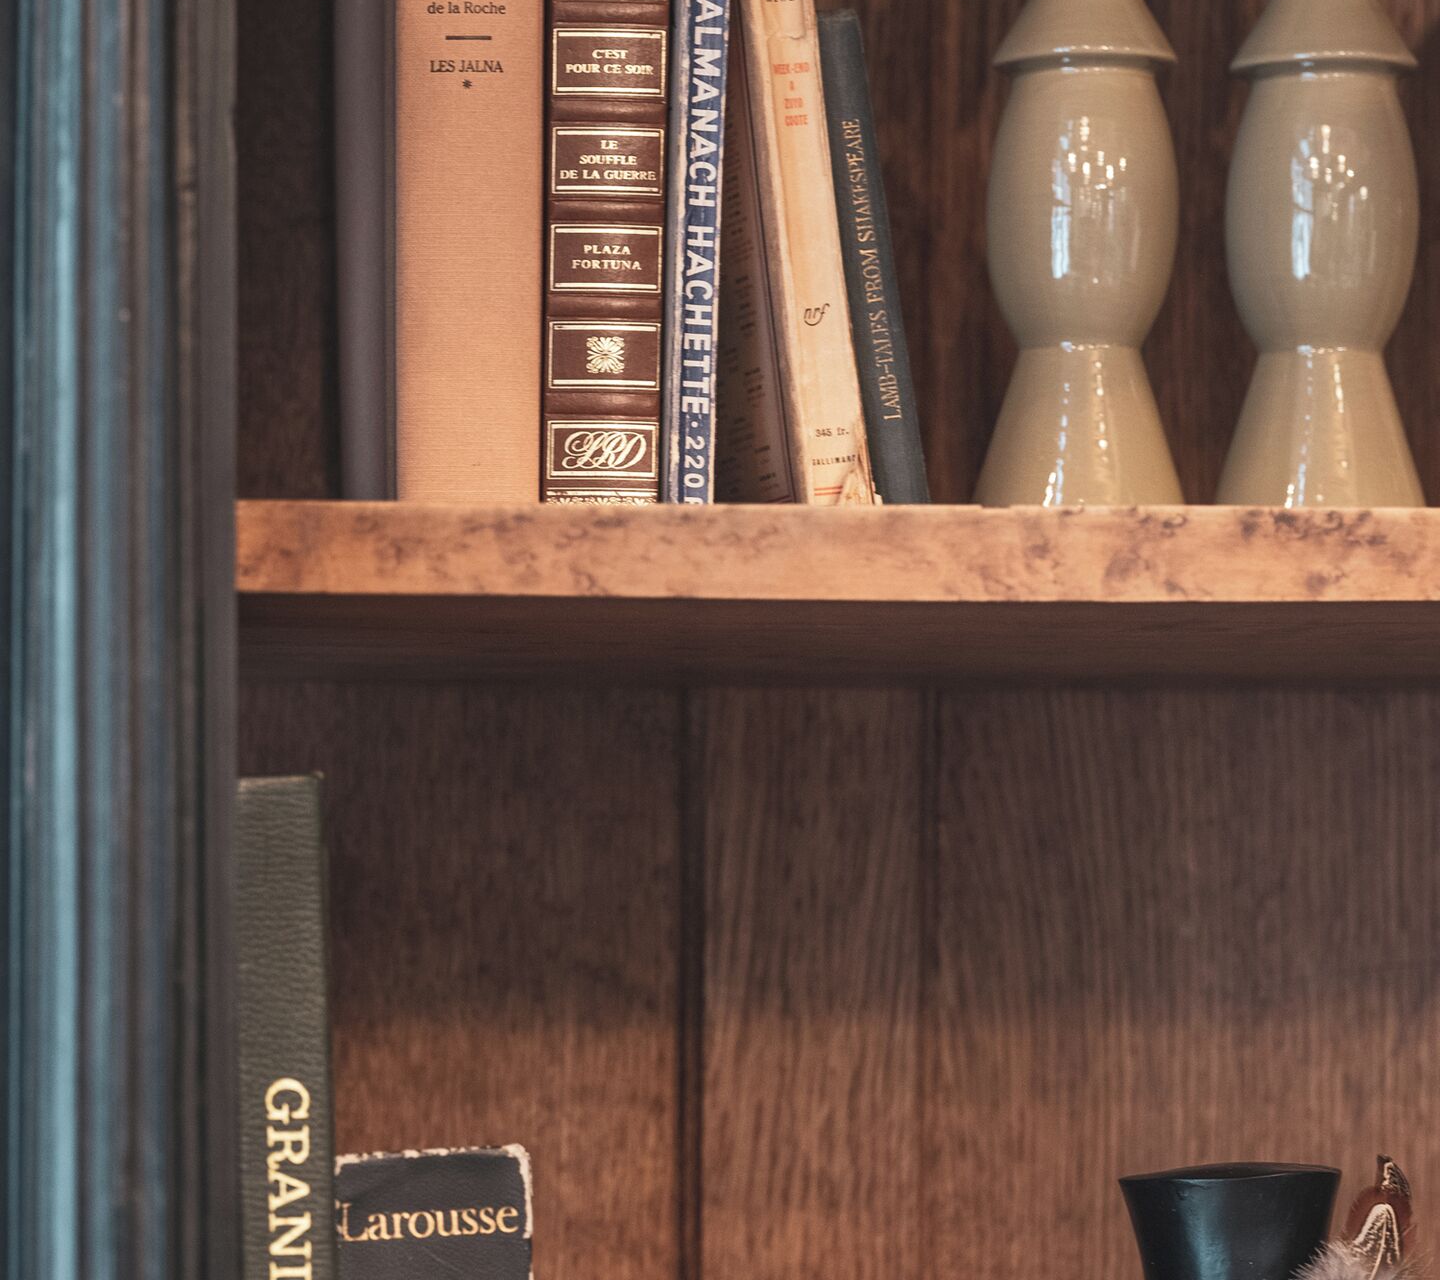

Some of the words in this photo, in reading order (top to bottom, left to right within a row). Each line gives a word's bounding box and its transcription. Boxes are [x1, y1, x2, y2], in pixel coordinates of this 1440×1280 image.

[427, 2, 445, 14] de
[448, 2, 460, 14] la
[464, 2, 506, 14] Roche
[430, 60, 455, 73] LES
[459, 60, 504, 73] JALNA
[565, 64, 600, 74] POUR
[603, 64, 622, 74] CE
[624, 65, 654, 75] SOIR
[600, 140, 619, 150] LE
[579, 155, 638, 165] SOUFFLE
[559, 170, 578, 179] DE
[583, 170, 600, 179] LA
[604, 170, 656, 181] GUERRE
[842, 119, 876, 243] SHAKESPEARE
[583, 245, 632, 255] PLAZA
[572, 259, 642, 270] FORTUNA
[858, 249, 884, 304] FROM
[681, 224, 714, 415] HACHETTE
[804, 303, 830, 326] nrf
[684, 436, 706, 489] 220
[341, 1202, 519, 1242] Larousse
